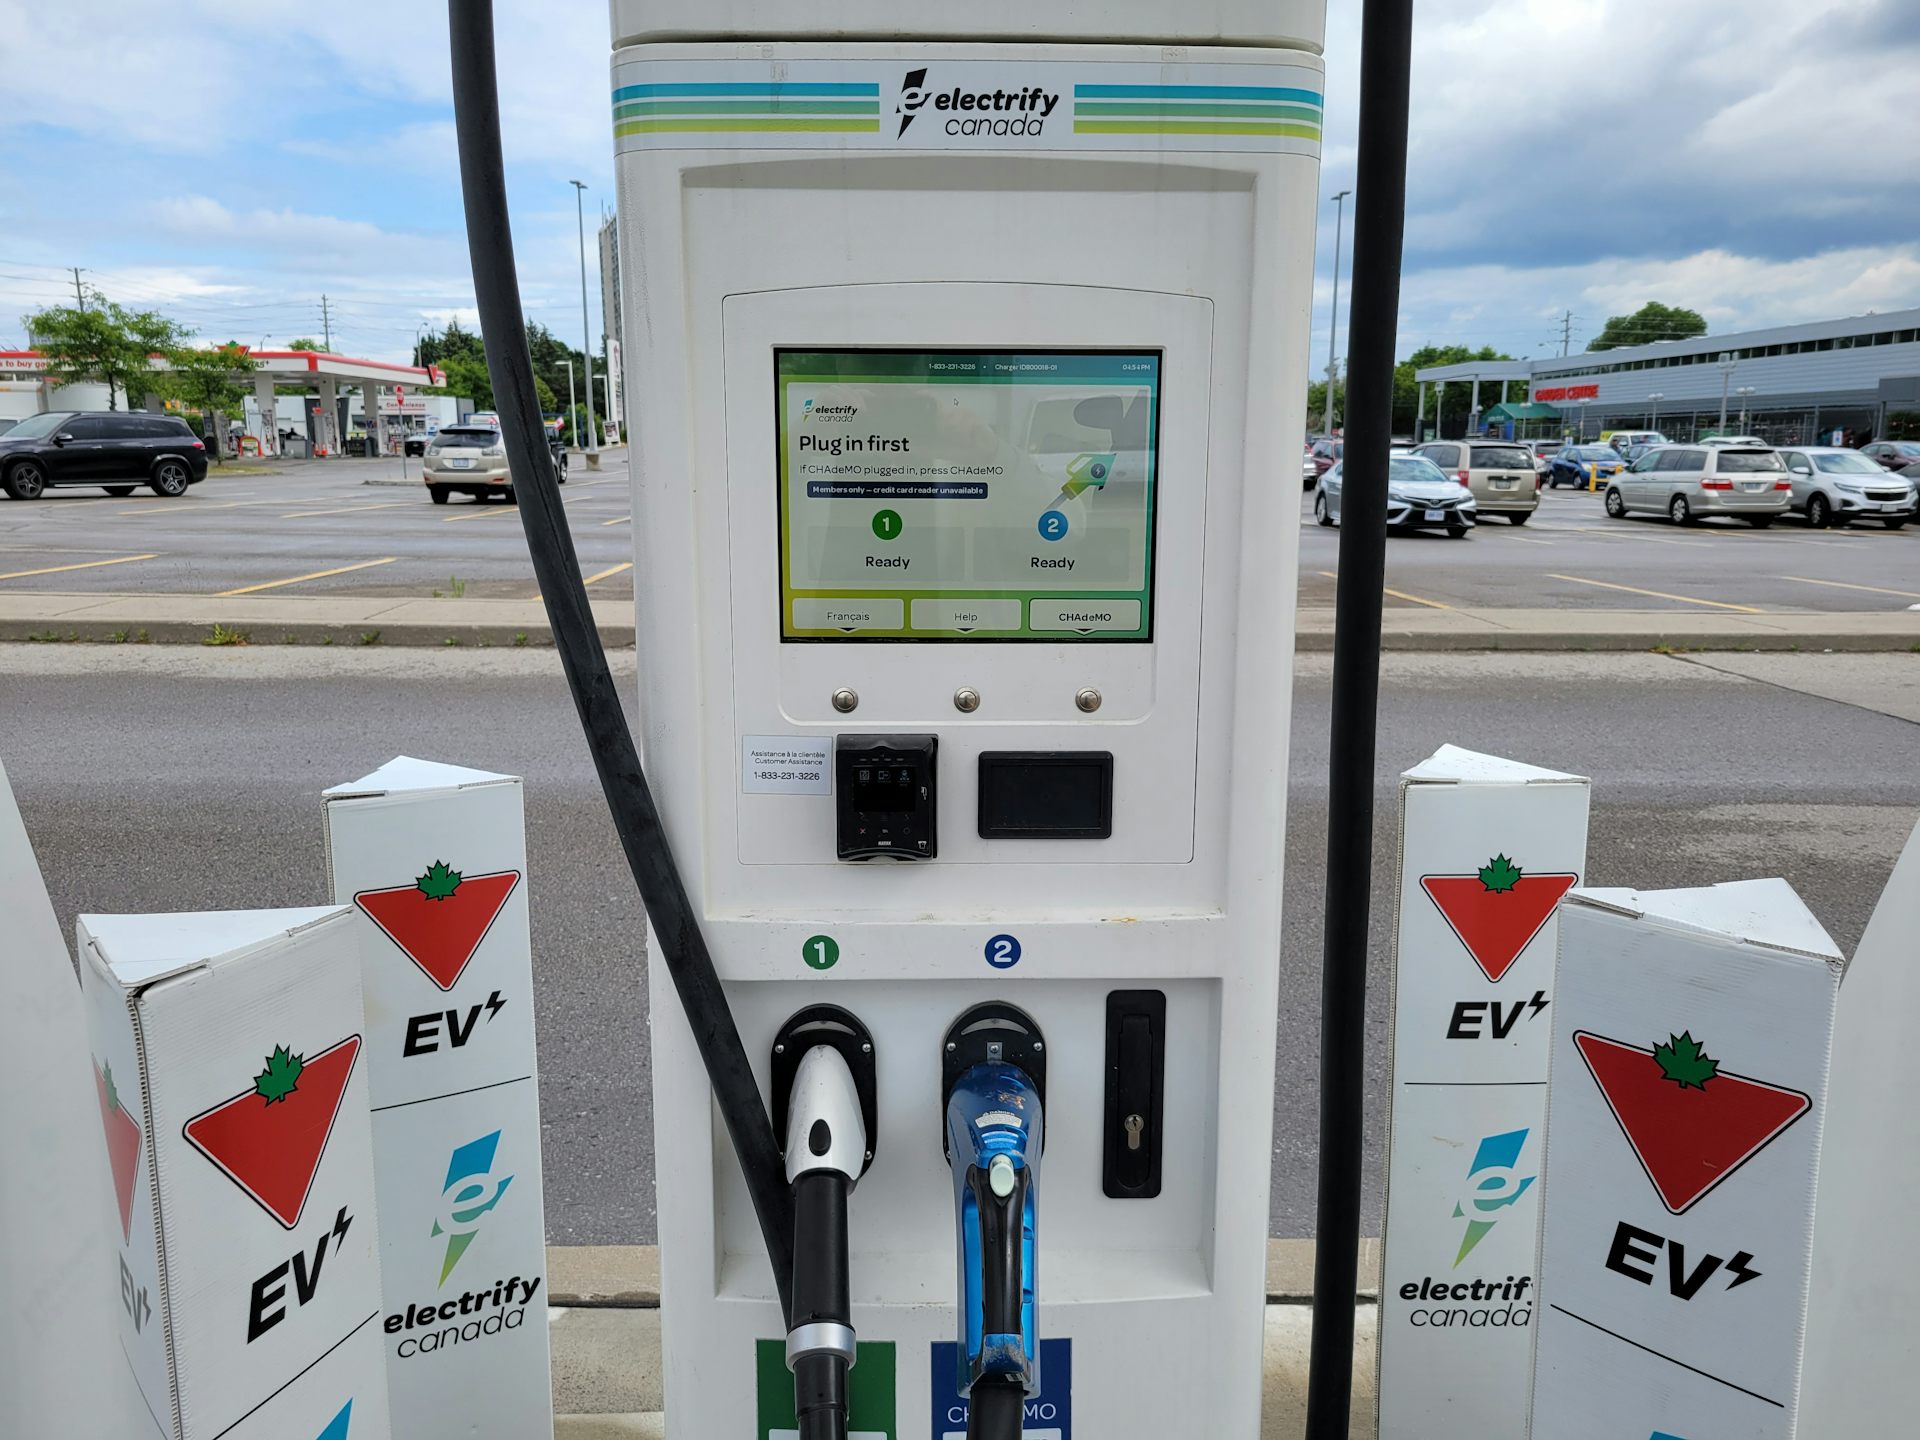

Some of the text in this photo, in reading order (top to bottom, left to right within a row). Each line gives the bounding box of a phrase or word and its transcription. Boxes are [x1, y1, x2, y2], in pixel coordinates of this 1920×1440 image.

[935, 87, 1059, 117] electrify
[945, 113, 1044, 136] canada
[995, 364, 1018, 372] Charger
[815, 406, 858, 415] electrify
[818, 414, 853, 422] canada
[799, 434, 910, 456] Plug in first
[799, 464, 1004, 476] If CHAdeMO plugged in, press CHAdeMO
[812, 486, 848, 494] Members
[848, 486, 865, 494] only
[873, 486, 895, 494] credit
[896, 486, 914, 494] card
[914, 486, 939, 494] reader
[940, 486, 984, 494] unavailable
[882, 516, 890, 532] 1
[1047, 518, 1059, 533] 2
[865, 555, 911, 570] Ready
[1030, 556, 1076, 571] Ready
[826, 611, 870, 623] Français
[954, 612, 978, 623] Help
[1058, 613, 1112, 622] CHAdeMO
[754, 771, 820, 781] 1-833-231-3226
[814, 941, 826, 963] 1
[994, 940, 1013, 963] 2
[1446, 1001, 1526, 1039] EV
[402, 1004, 484, 1058] EV
[1605, 1220, 1724, 1301] EV
[247, 1231, 331, 1345] EV
[1400, 1276, 1533, 1306] electrif
[384, 1276, 541, 1334] electrify
[1410, 1302, 1531, 1327] canada
[398, 1306, 525, 1358] canada
